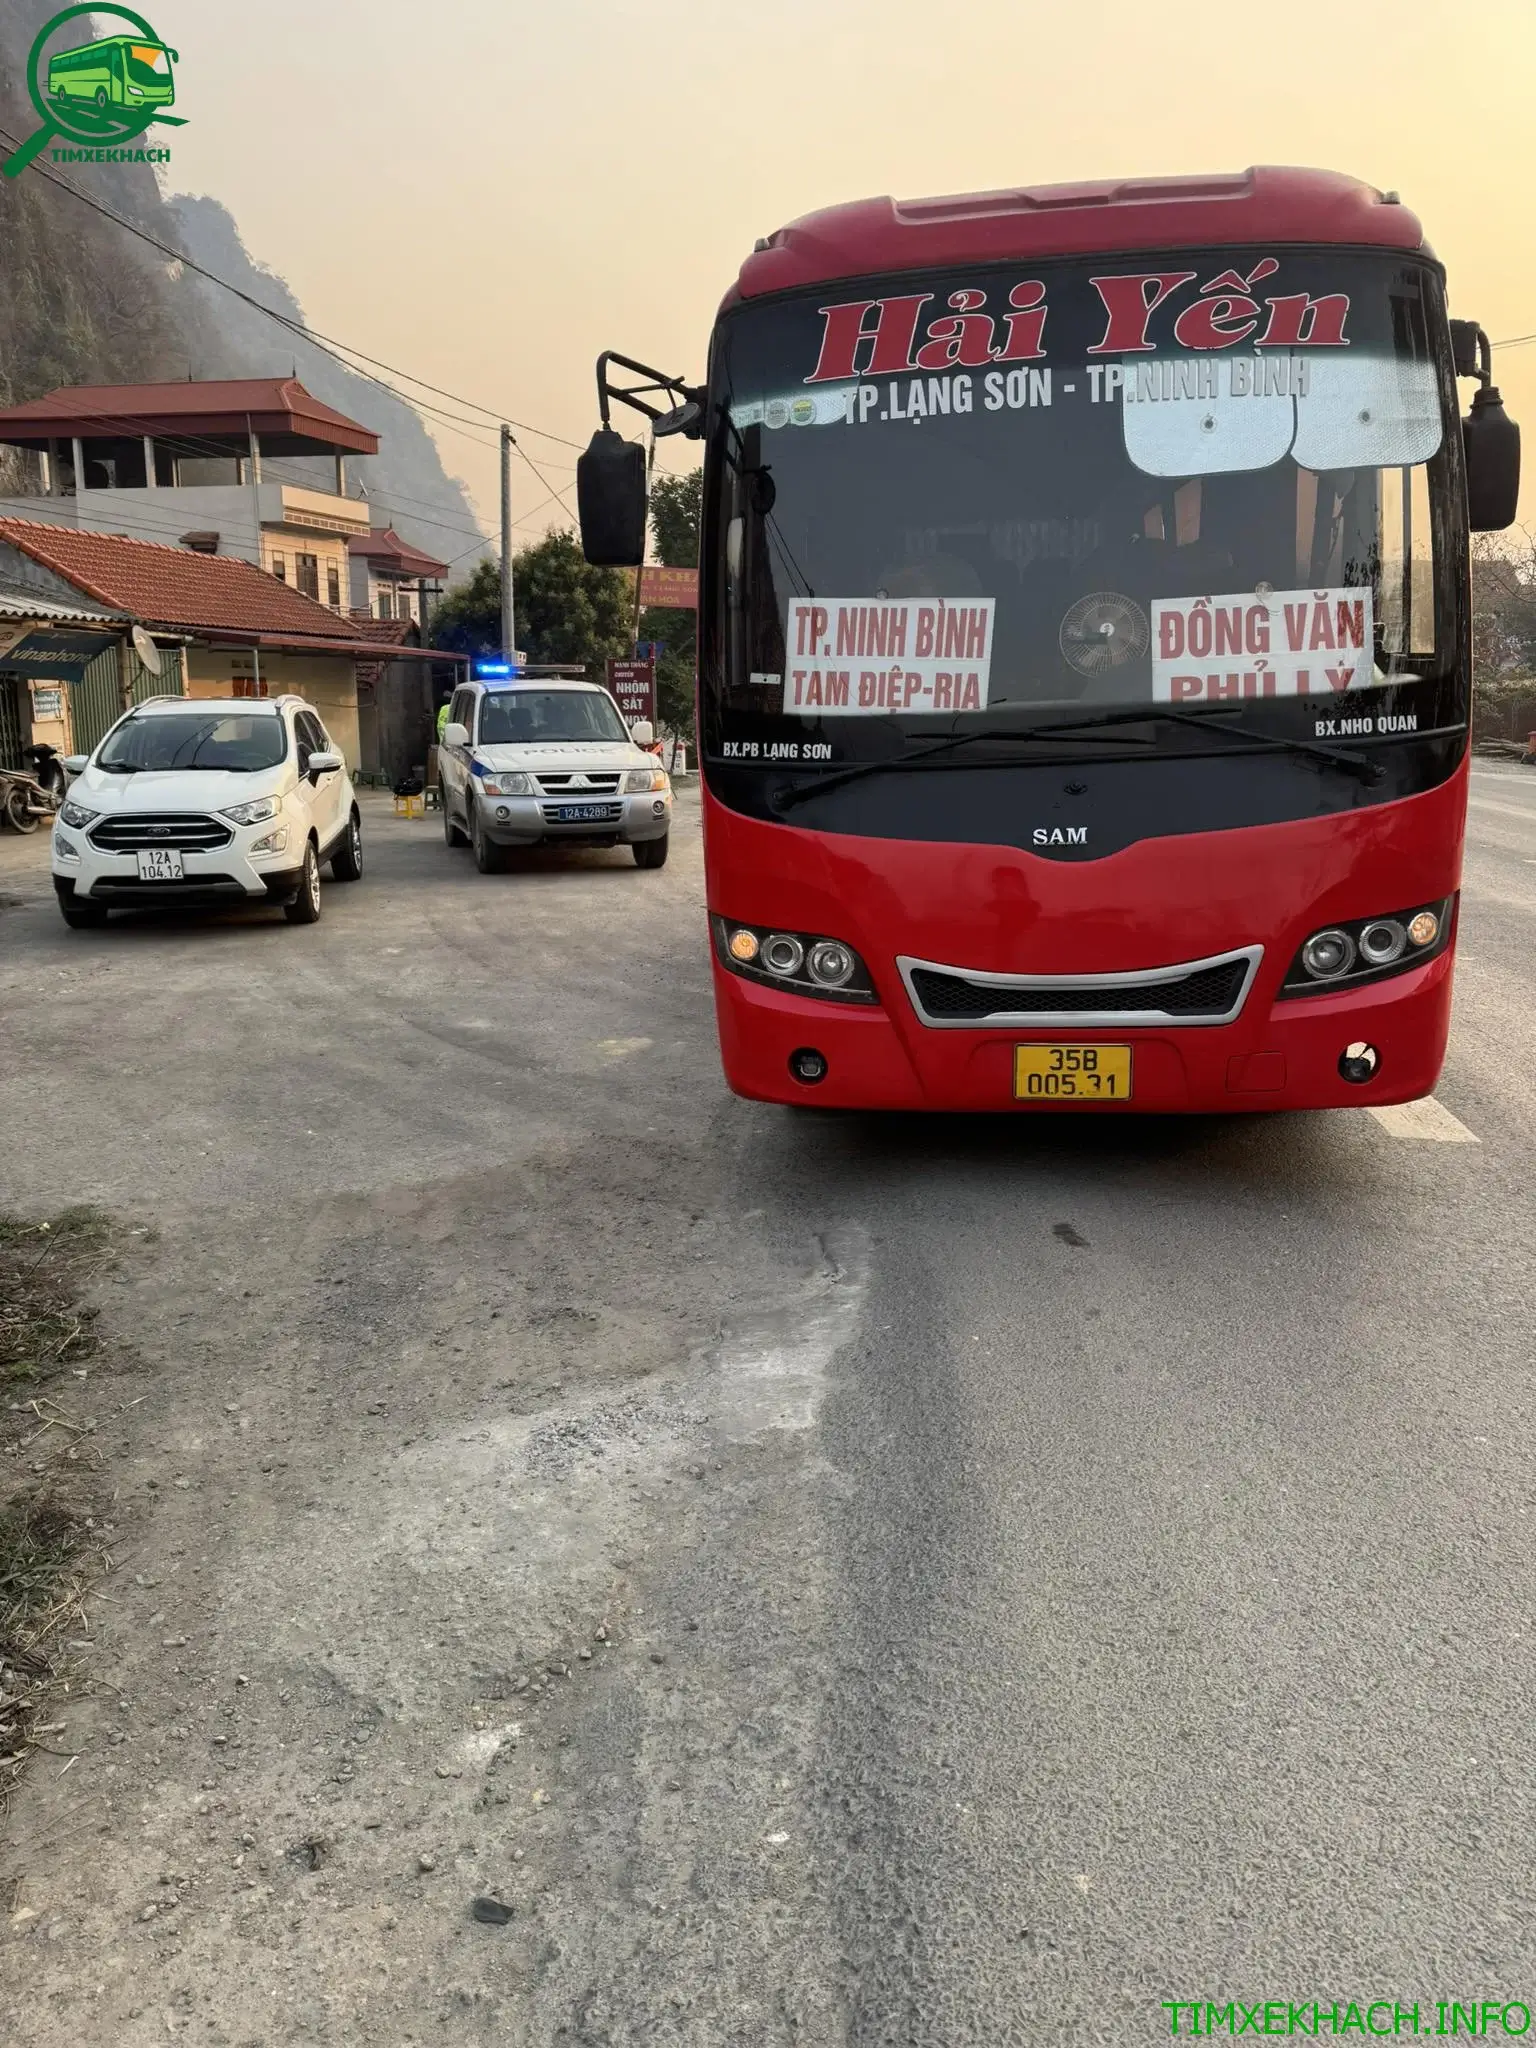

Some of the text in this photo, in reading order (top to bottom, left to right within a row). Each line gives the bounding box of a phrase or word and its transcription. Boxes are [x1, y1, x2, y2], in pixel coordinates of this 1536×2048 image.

[804, 257, 1351, 383] Hải Yến
[843, 373, 973, 424] TP.LẠNG
[983, 362, 1053, 408] SƠN
[1086, 357, 1219, 402] TP.NINH
[1231, 349, 1310, 398] BÌNH
[915, 599, 988, 658] BÌNH
[1159, 591, 1364, 659] ĐỒNG VĂN
[616, 680, 649, 693] NHÔM
[792, 670, 850, 706] TAM
[1315, 714, 1417, 736] BX.NHO QUAN
[723, 742, 832, 760] BX.PB LẠNG SƠN
[1033, 827, 1088, 845] SAM
[149, 851, 171, 864] 12A
[142, 864, 182, 878] 104.12
[1049, 1049, 1098, 1071] 35B
[1028, 1073, 1116, 1096] 005.31
